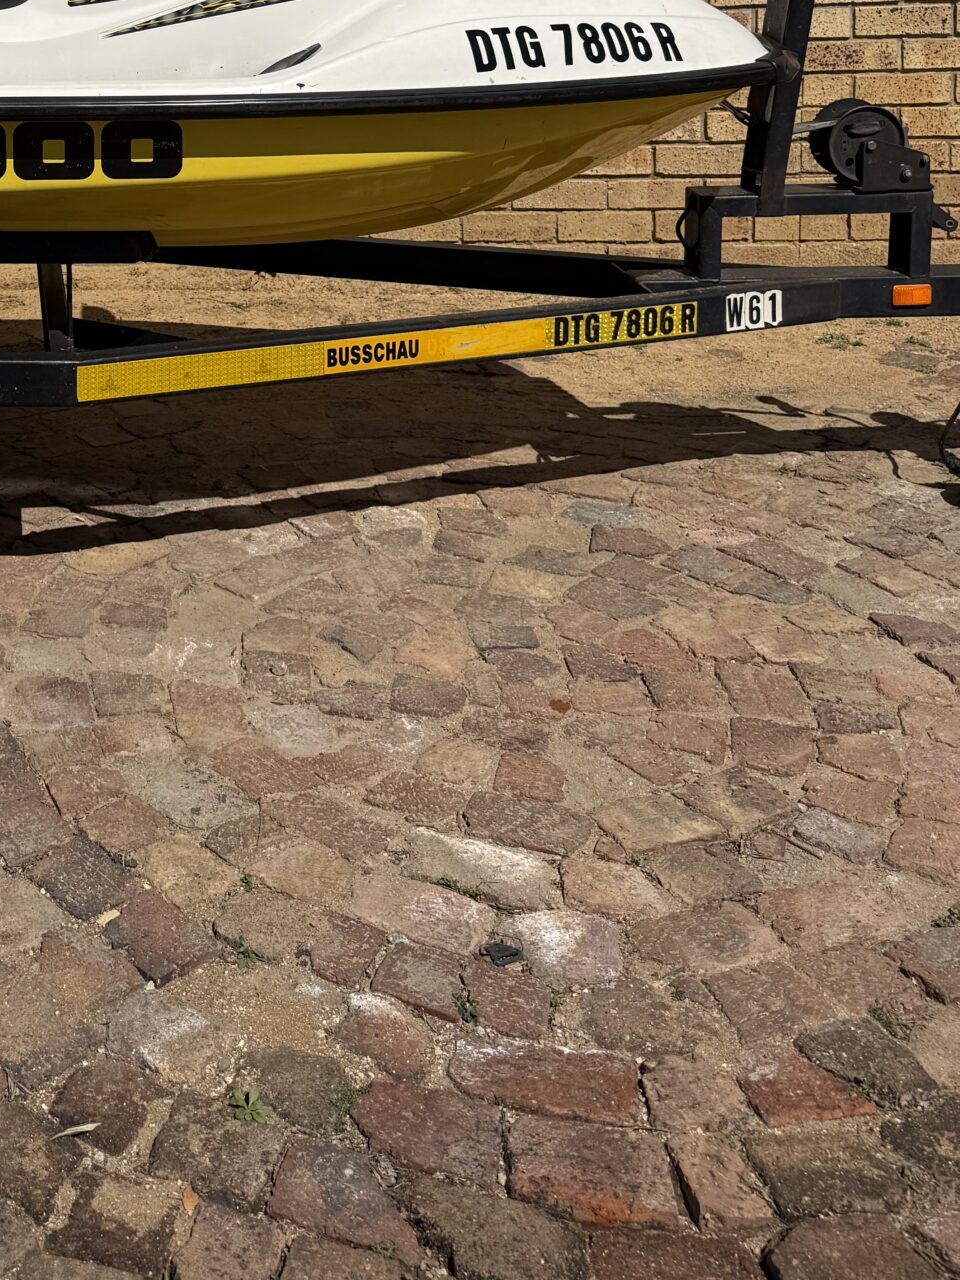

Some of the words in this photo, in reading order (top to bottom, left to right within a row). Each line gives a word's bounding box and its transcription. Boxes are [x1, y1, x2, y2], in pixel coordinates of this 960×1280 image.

[465, 25, 546, 73] DTG
[549, 22, 653, 66] 7806
[649, 22, 684, 62] R
[554, 313, 600, 347] DTG
[610, 305, 675, 341] 7806
[680, 303, 697, 333] R
[727, 292, 778, 328] W61
[326, 339, 420, 368] BUSSCHAU
